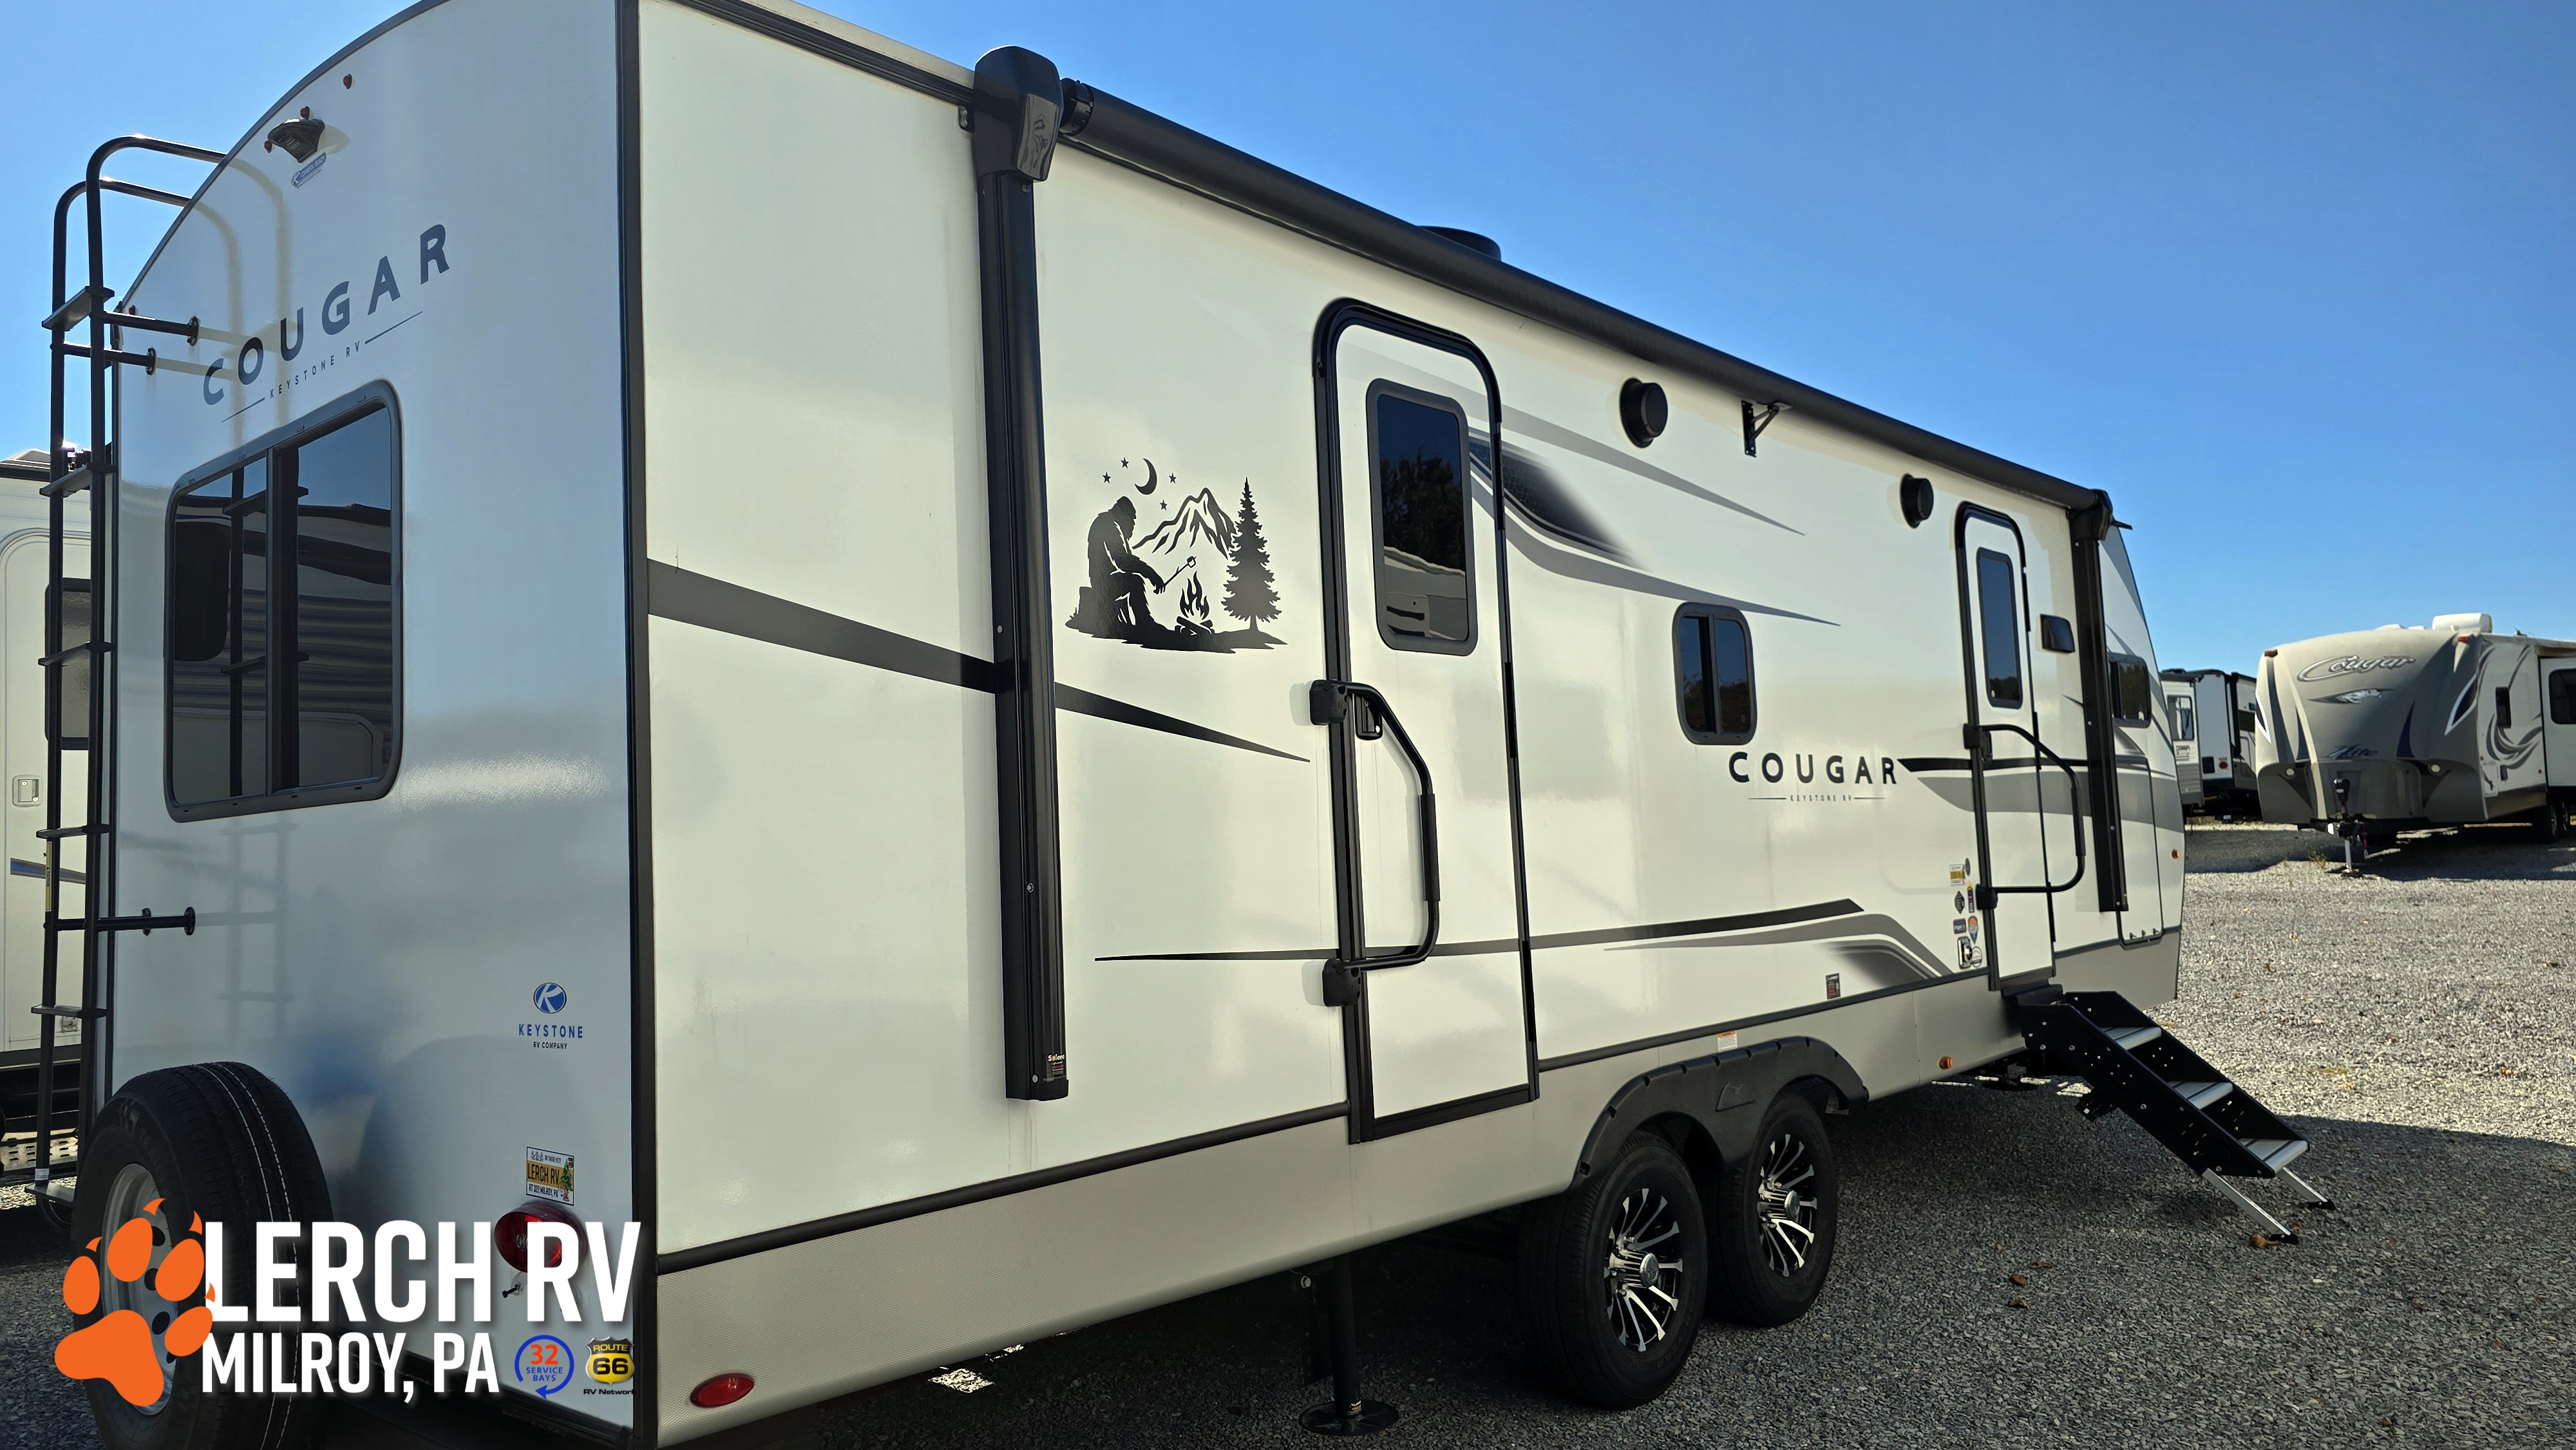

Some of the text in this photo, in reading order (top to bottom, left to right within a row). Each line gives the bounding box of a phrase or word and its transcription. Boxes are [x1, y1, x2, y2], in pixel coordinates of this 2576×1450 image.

[203, 224, 450, 406] COUGAR
[269, 341, 360, 399] KEYSTONE RV
[2297, 654, 2416, 682] Cougar
[1728, 751, 1897, 784] COUGAR
[518, 1024, 583, 1039] KEYSTONE
[528, 1162, 560, 1185] LERCH RV
